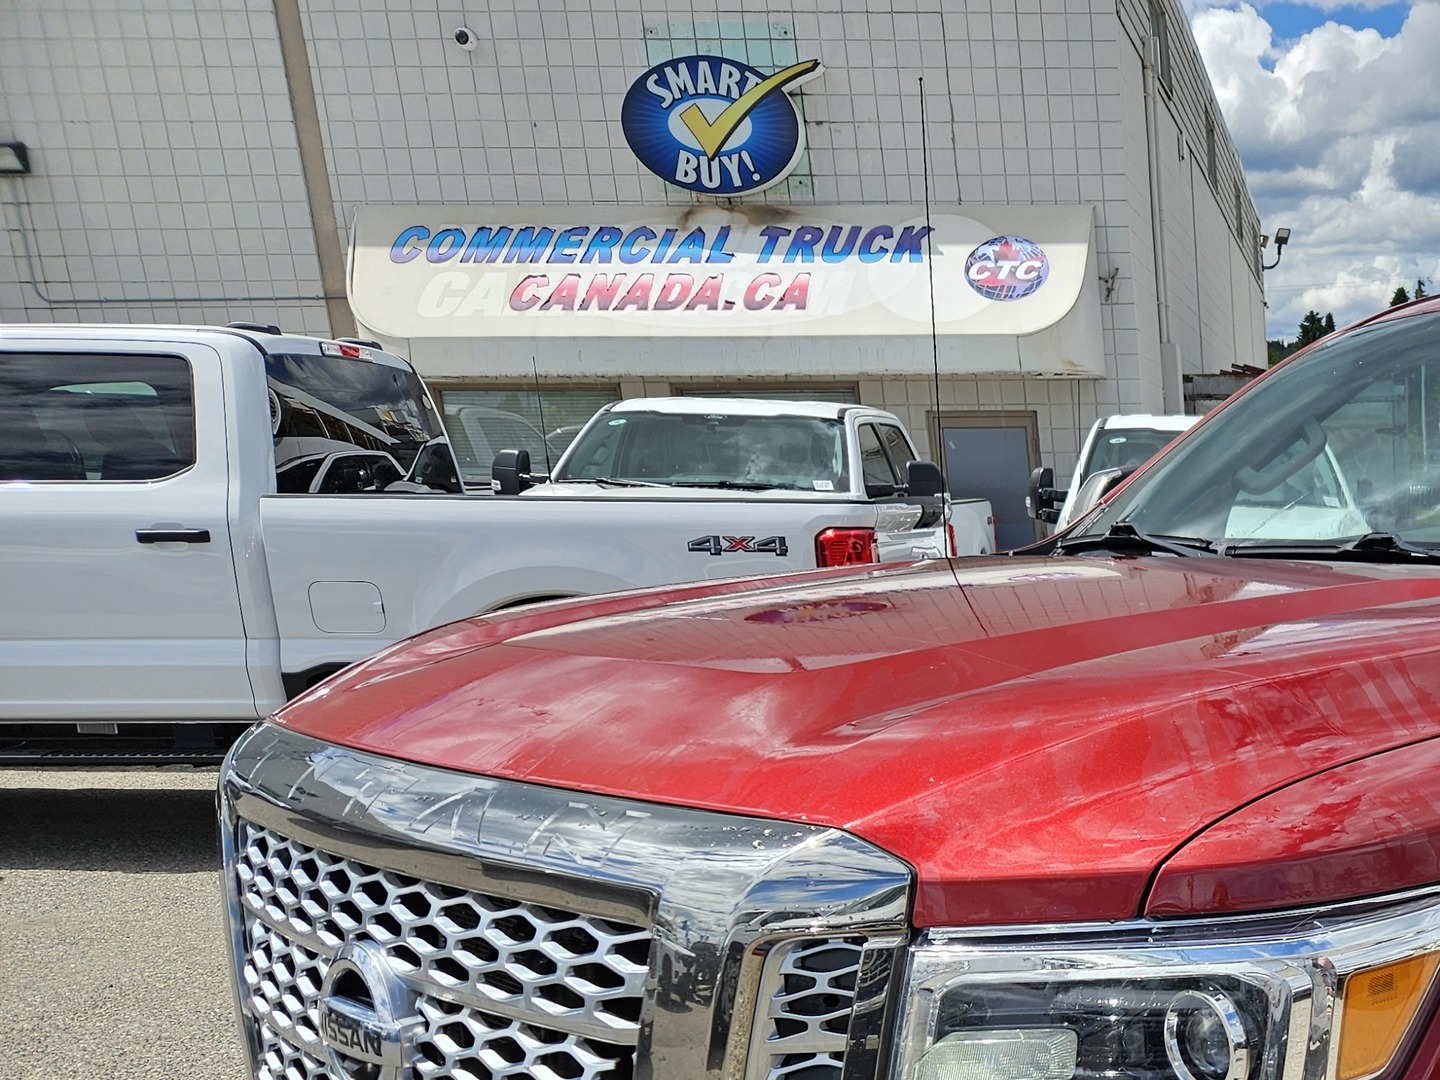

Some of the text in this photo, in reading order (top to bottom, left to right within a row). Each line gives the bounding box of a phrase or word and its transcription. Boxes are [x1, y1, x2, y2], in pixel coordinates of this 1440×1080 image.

[646, 61, 763, 109] SMART
[675, 149, 762, 189] BUY!
[389, 224, 936, 265] COMMERCIAL TRUCK
[968, 260, 1043, 281] CTC
[508, 271, 813, 313] CANADA.CA
